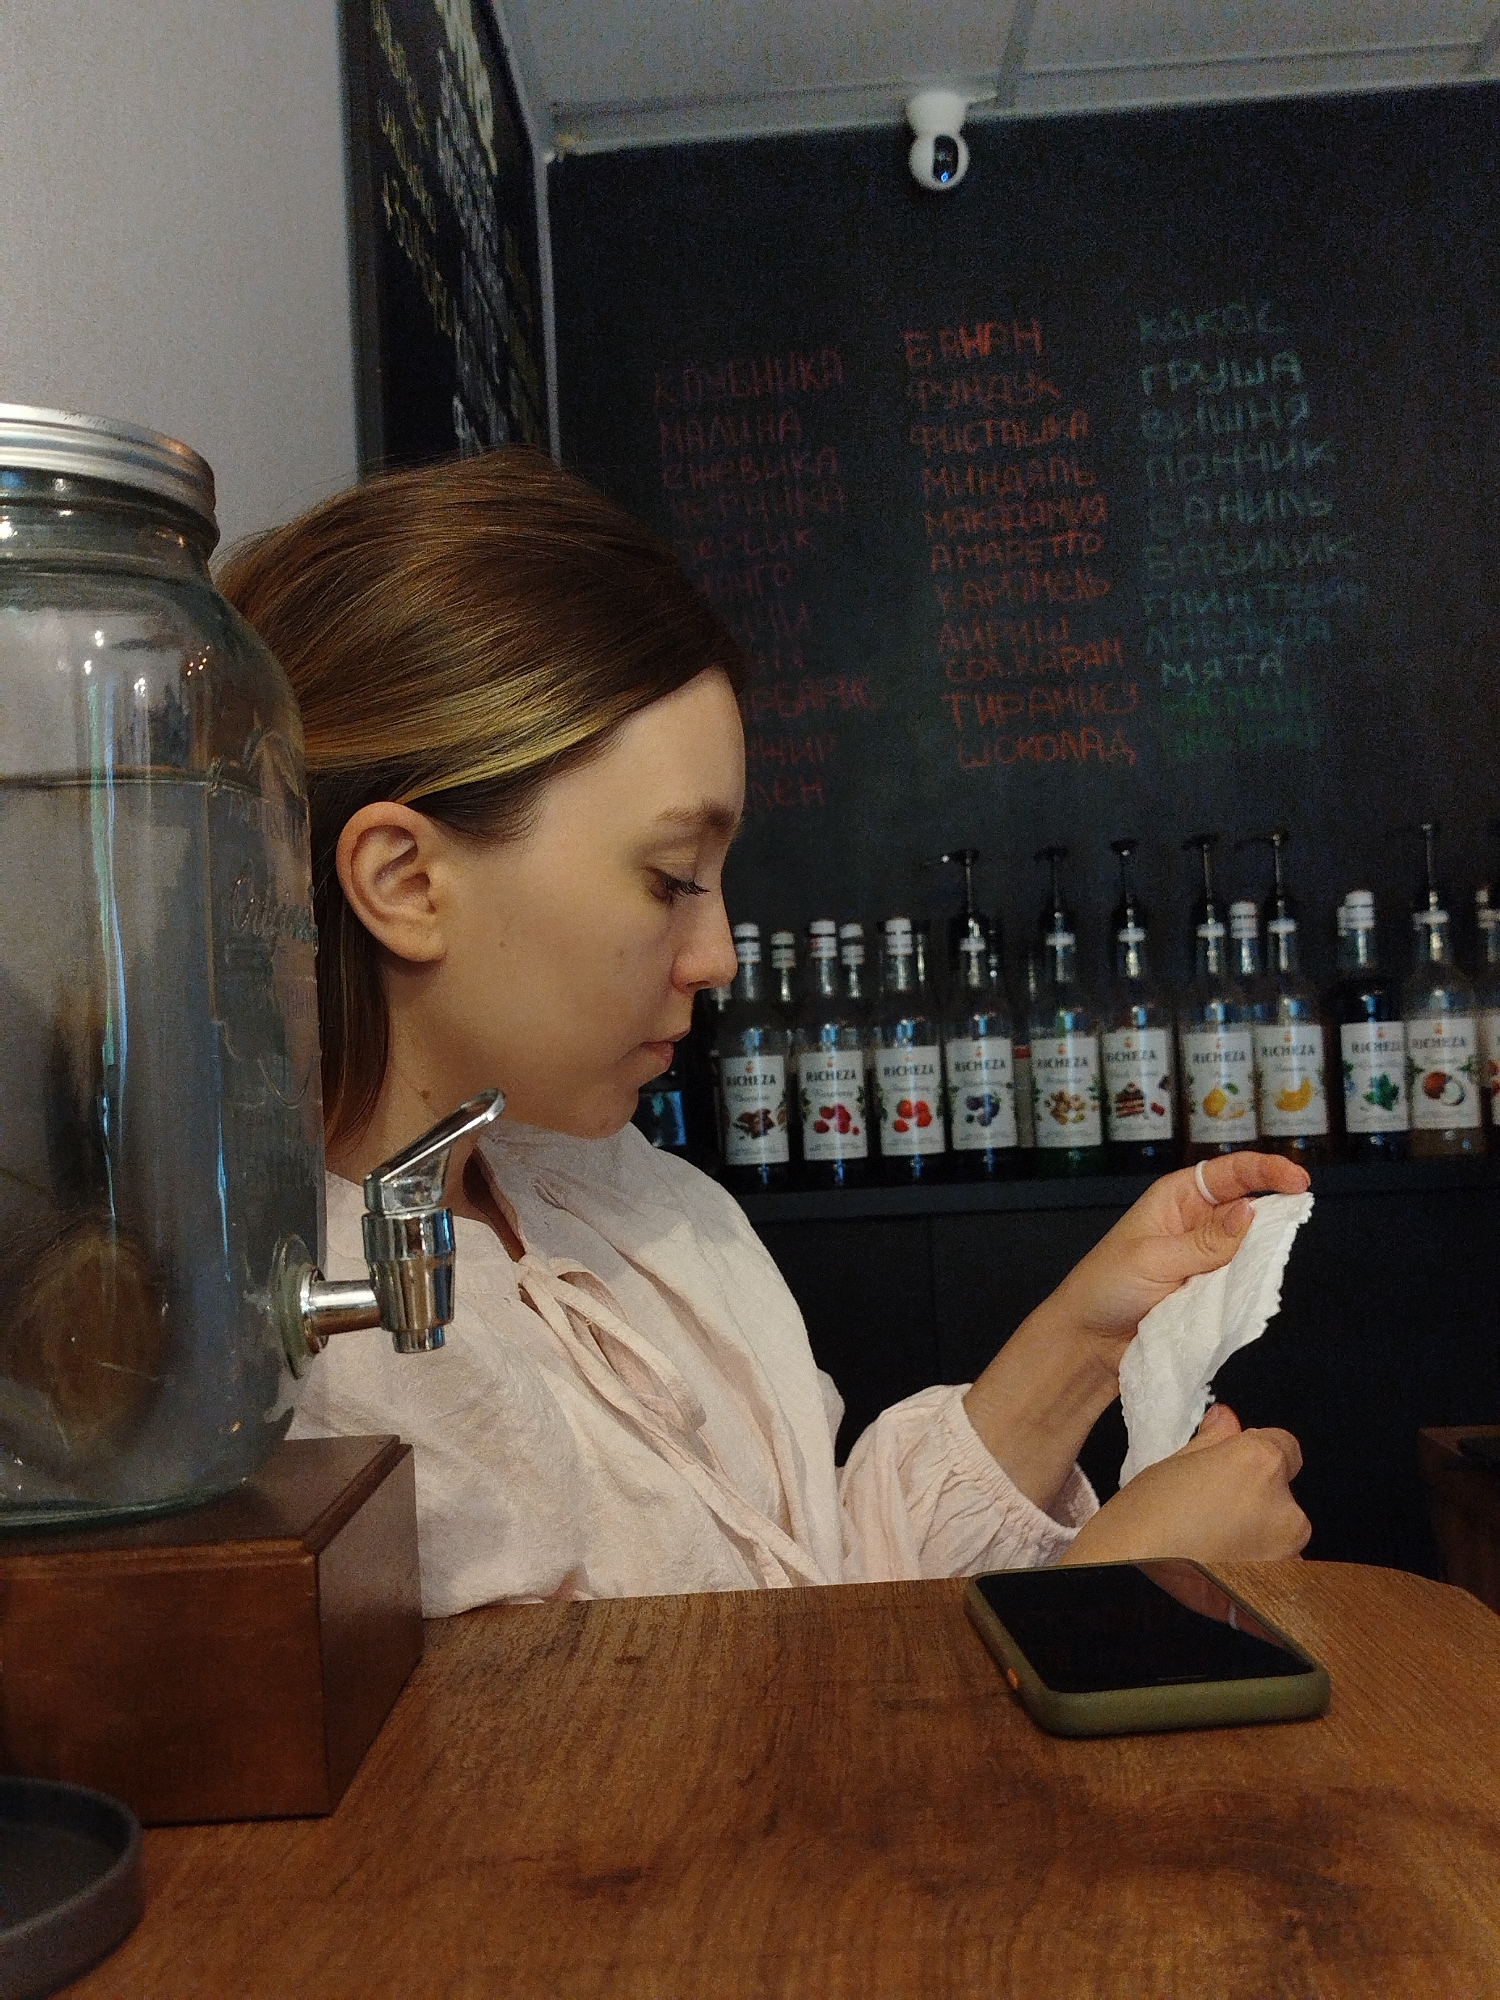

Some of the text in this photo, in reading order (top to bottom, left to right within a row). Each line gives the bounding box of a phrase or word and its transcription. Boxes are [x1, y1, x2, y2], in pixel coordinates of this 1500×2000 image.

[902, 317, 1043, 367] БАНАН
[1140, 350, 1304, 396] ГРУША
[657, 405, 803, 458] МАЛИНА
[908, 409, 1090, 458] ФИСТАШКА
[1139, 392, 1310, 443] ВИШНЯ
[922, 455, 1097, 500] МИНДАЛЬ
[1147, 489, 1334, 537] ВАНИЛЬ
[930, 528, 1104, 574] АМАРЕТТО
[933, 566, 1111, 614] КАРАМЕЛЬ
[1161, 652, 1284, 687] МЯТА
[941, 682, 1138, 731] ТИРАМИСУ
[957, 725, 1136, 768] ШОКОЛАД
